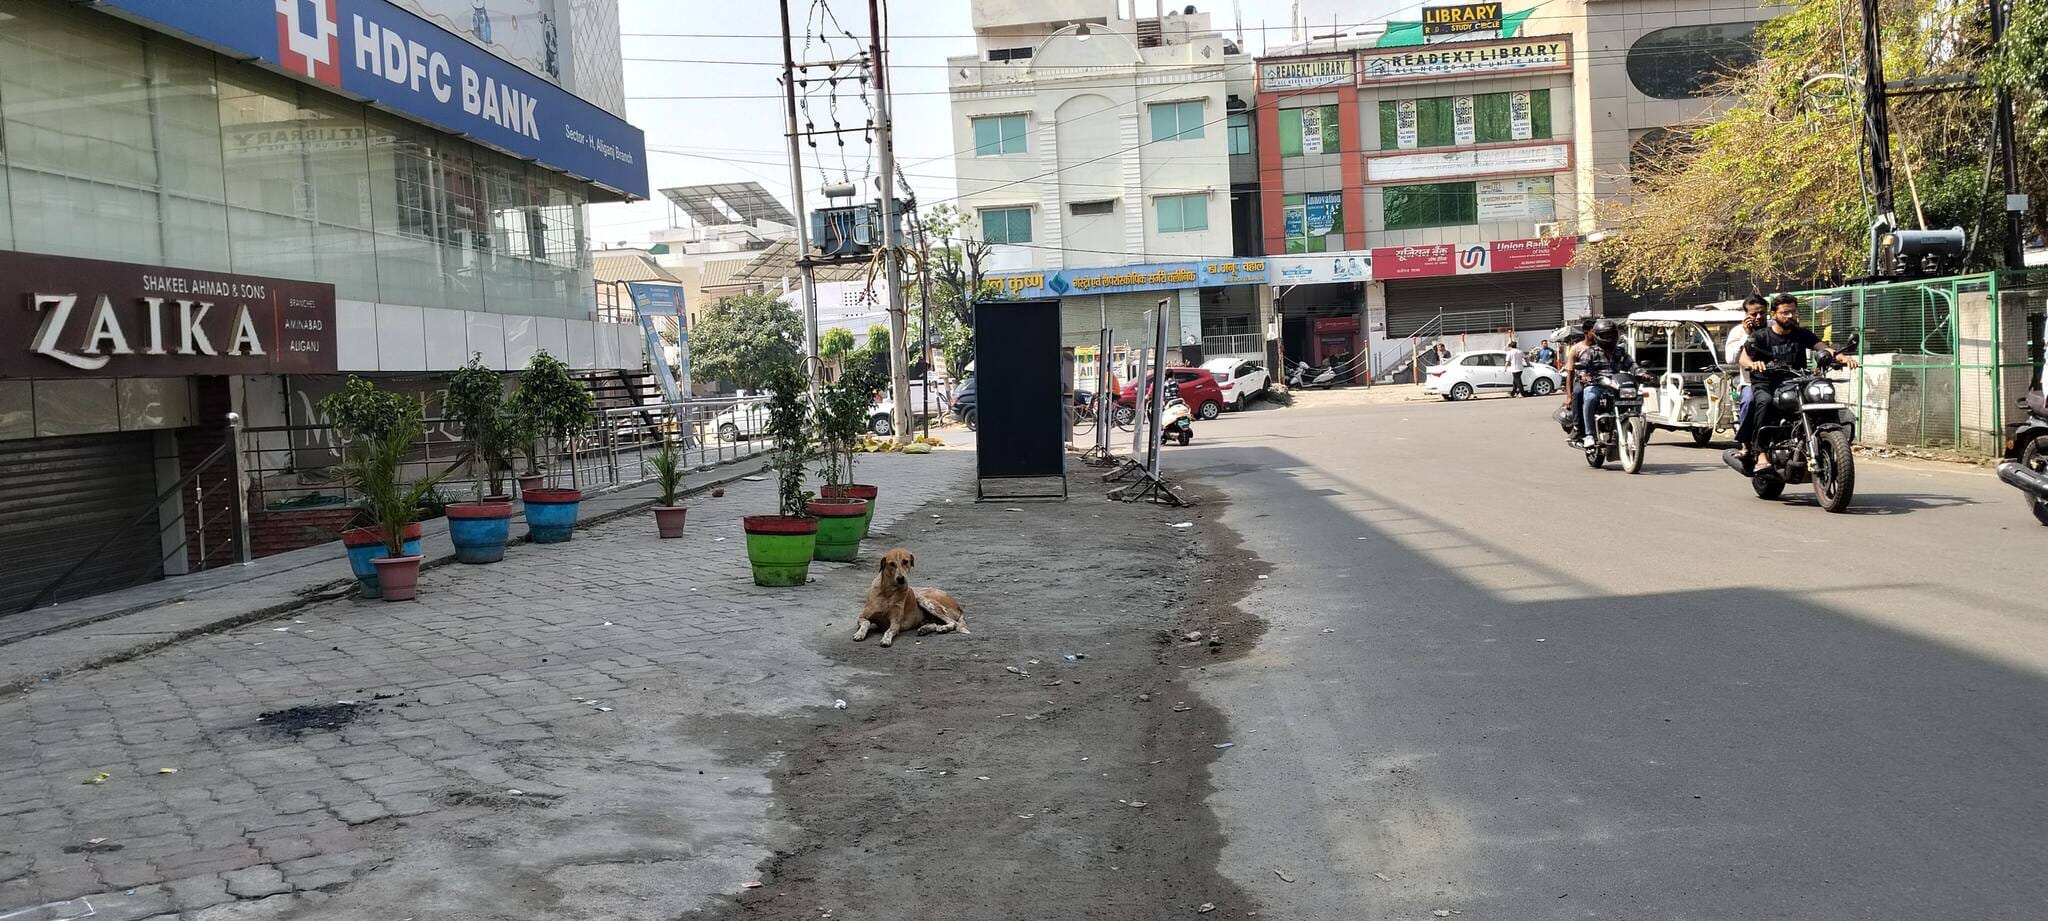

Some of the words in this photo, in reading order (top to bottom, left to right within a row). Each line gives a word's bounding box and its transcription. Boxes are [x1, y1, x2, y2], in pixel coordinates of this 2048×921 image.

[1426, 5, 1497, 24] LIBRARY
[1451, 23, 1472, 32] STUDY
[1392, 50, 1475, 67] READEXT
[1480, 44, 1559, 61] LIBRARY
[1488, 58, 1523, 68] UNITE
[1528, 56, 1557, 64] HERE
[353, 14, 452, 103] HDFC
[461, 64, 540, 141] BANK
[1276, 64, 1311, 79] READEXT
[1313, 60, 1346, 76] LIBRARY
[565, 124, 585, 144] Sector
[589, 134, 596, 151] H,
[596, 137, 615, 160] Aliganj
[615, 145, 633, 165] Branch
[1307, 193, 1342, 205] Innovation
[1396, 247, 1431, 261] यूनियन
[1432, 245, 1448, 256] बैंक
[1497, 242, 1524, 251] Union
[1526, 240, 1550, 249] Bank
[143, 275, 190, 294] SHAKEEL
[191, 279, 230, 297] AHMAD
[232, 286, 239, 298] &
[241, 284, 266, 300] SONS
[1008, 273, 1044, 295] कृष्ण
[34, 292, 267, 370] ZAIKA
[285, 319, 322, 332] AMINABAD
[290, 341, 320, 353] ALIGANJ
